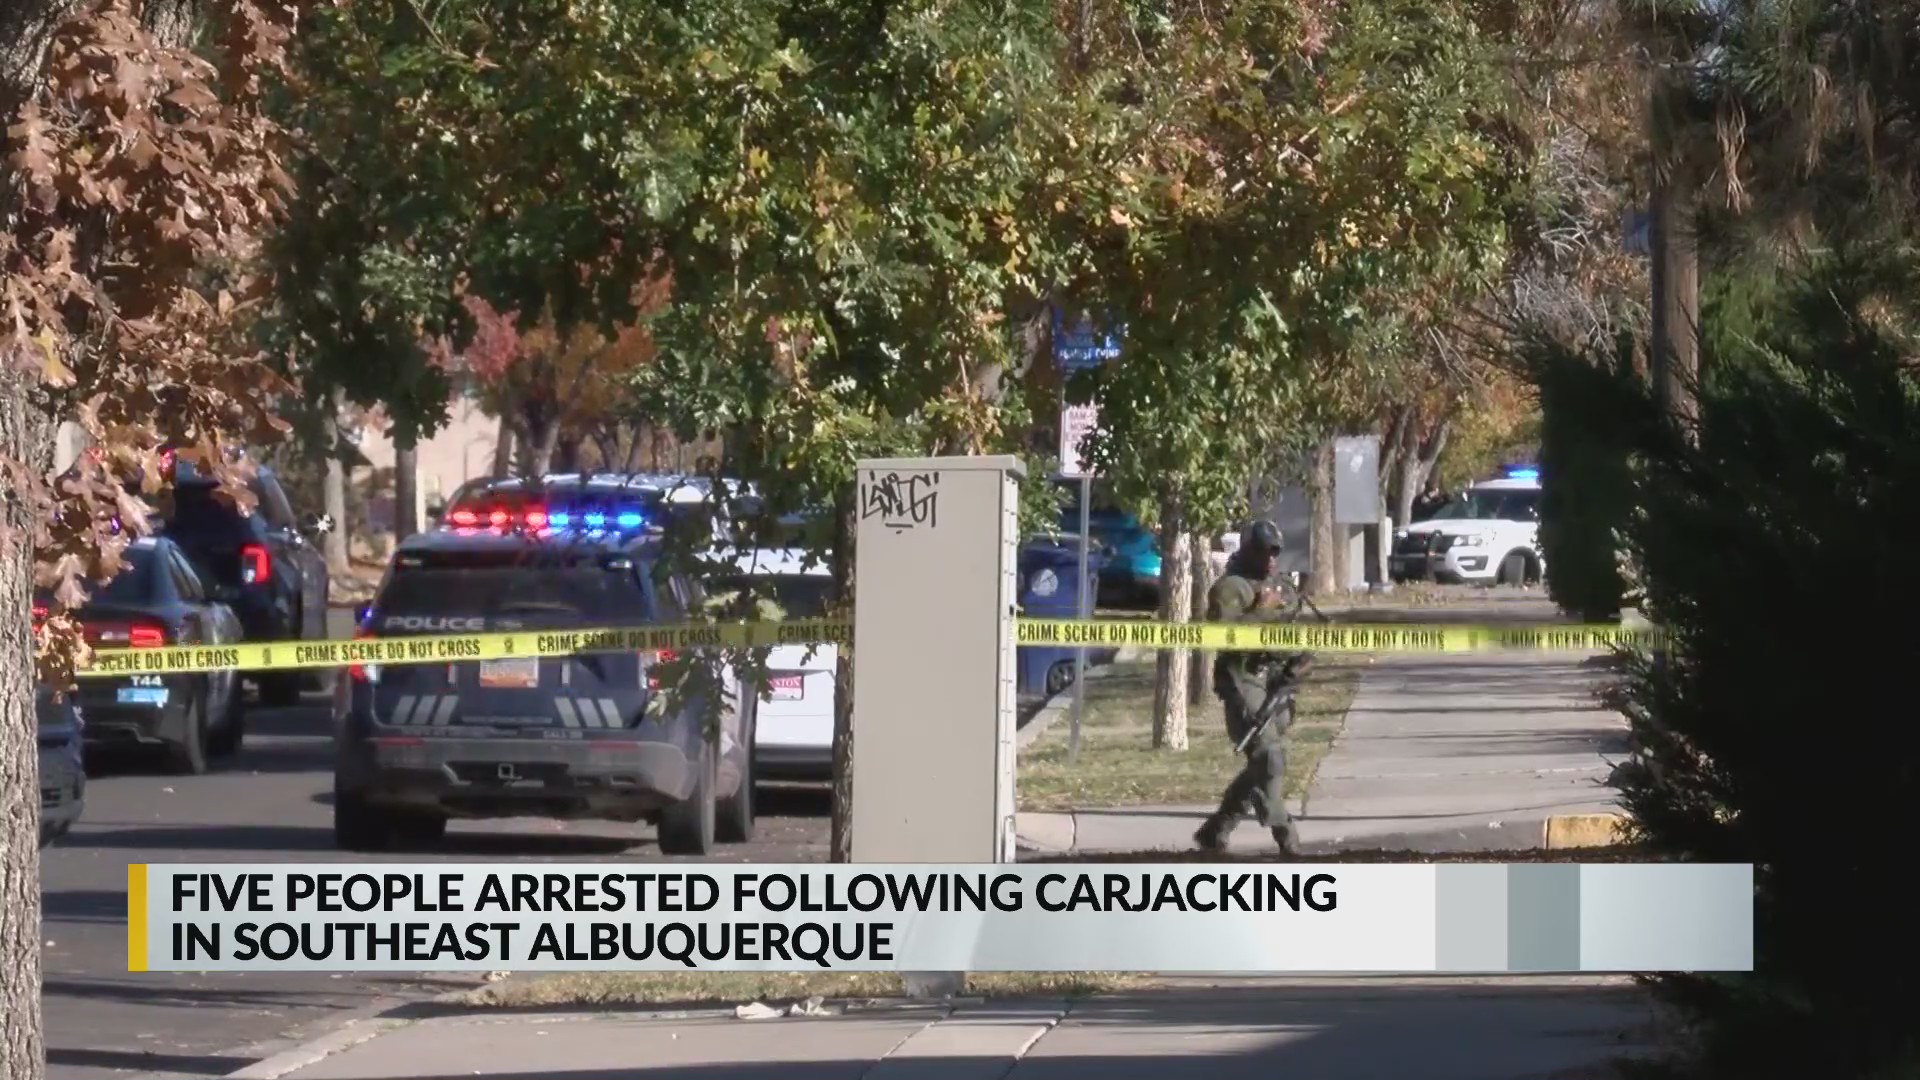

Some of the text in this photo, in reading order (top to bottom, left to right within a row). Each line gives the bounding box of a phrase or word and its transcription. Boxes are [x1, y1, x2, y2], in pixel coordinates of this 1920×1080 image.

[384, 616, 485, 630] POLICE
[777, 624, 820, 642] CRIME
[1018, 622, 1203, 644] CRIME SCENE DO NOT CROSS
[537, 633, 579, 653] CRIME
[629, 630, 646, 649] DO
[651, 628, 676, 648] NOT
[680, 626, 722, 646] CROSS
[1259, 627, 1302, 646] CRIME
[1306, 628, 1348, 647] SCENE
[1352, 629, 1369, 648] DO
[1373, 629, 1398, 648] NOT
[145, 653, 164, 670] DO
[167, 651, 191, 669] NOT
[196, 648, 240, 668] CROSS
[295, 637, 482, 664] CRIME SCENE DO NOT CROSS
[131, 675, 162, 687] T44
